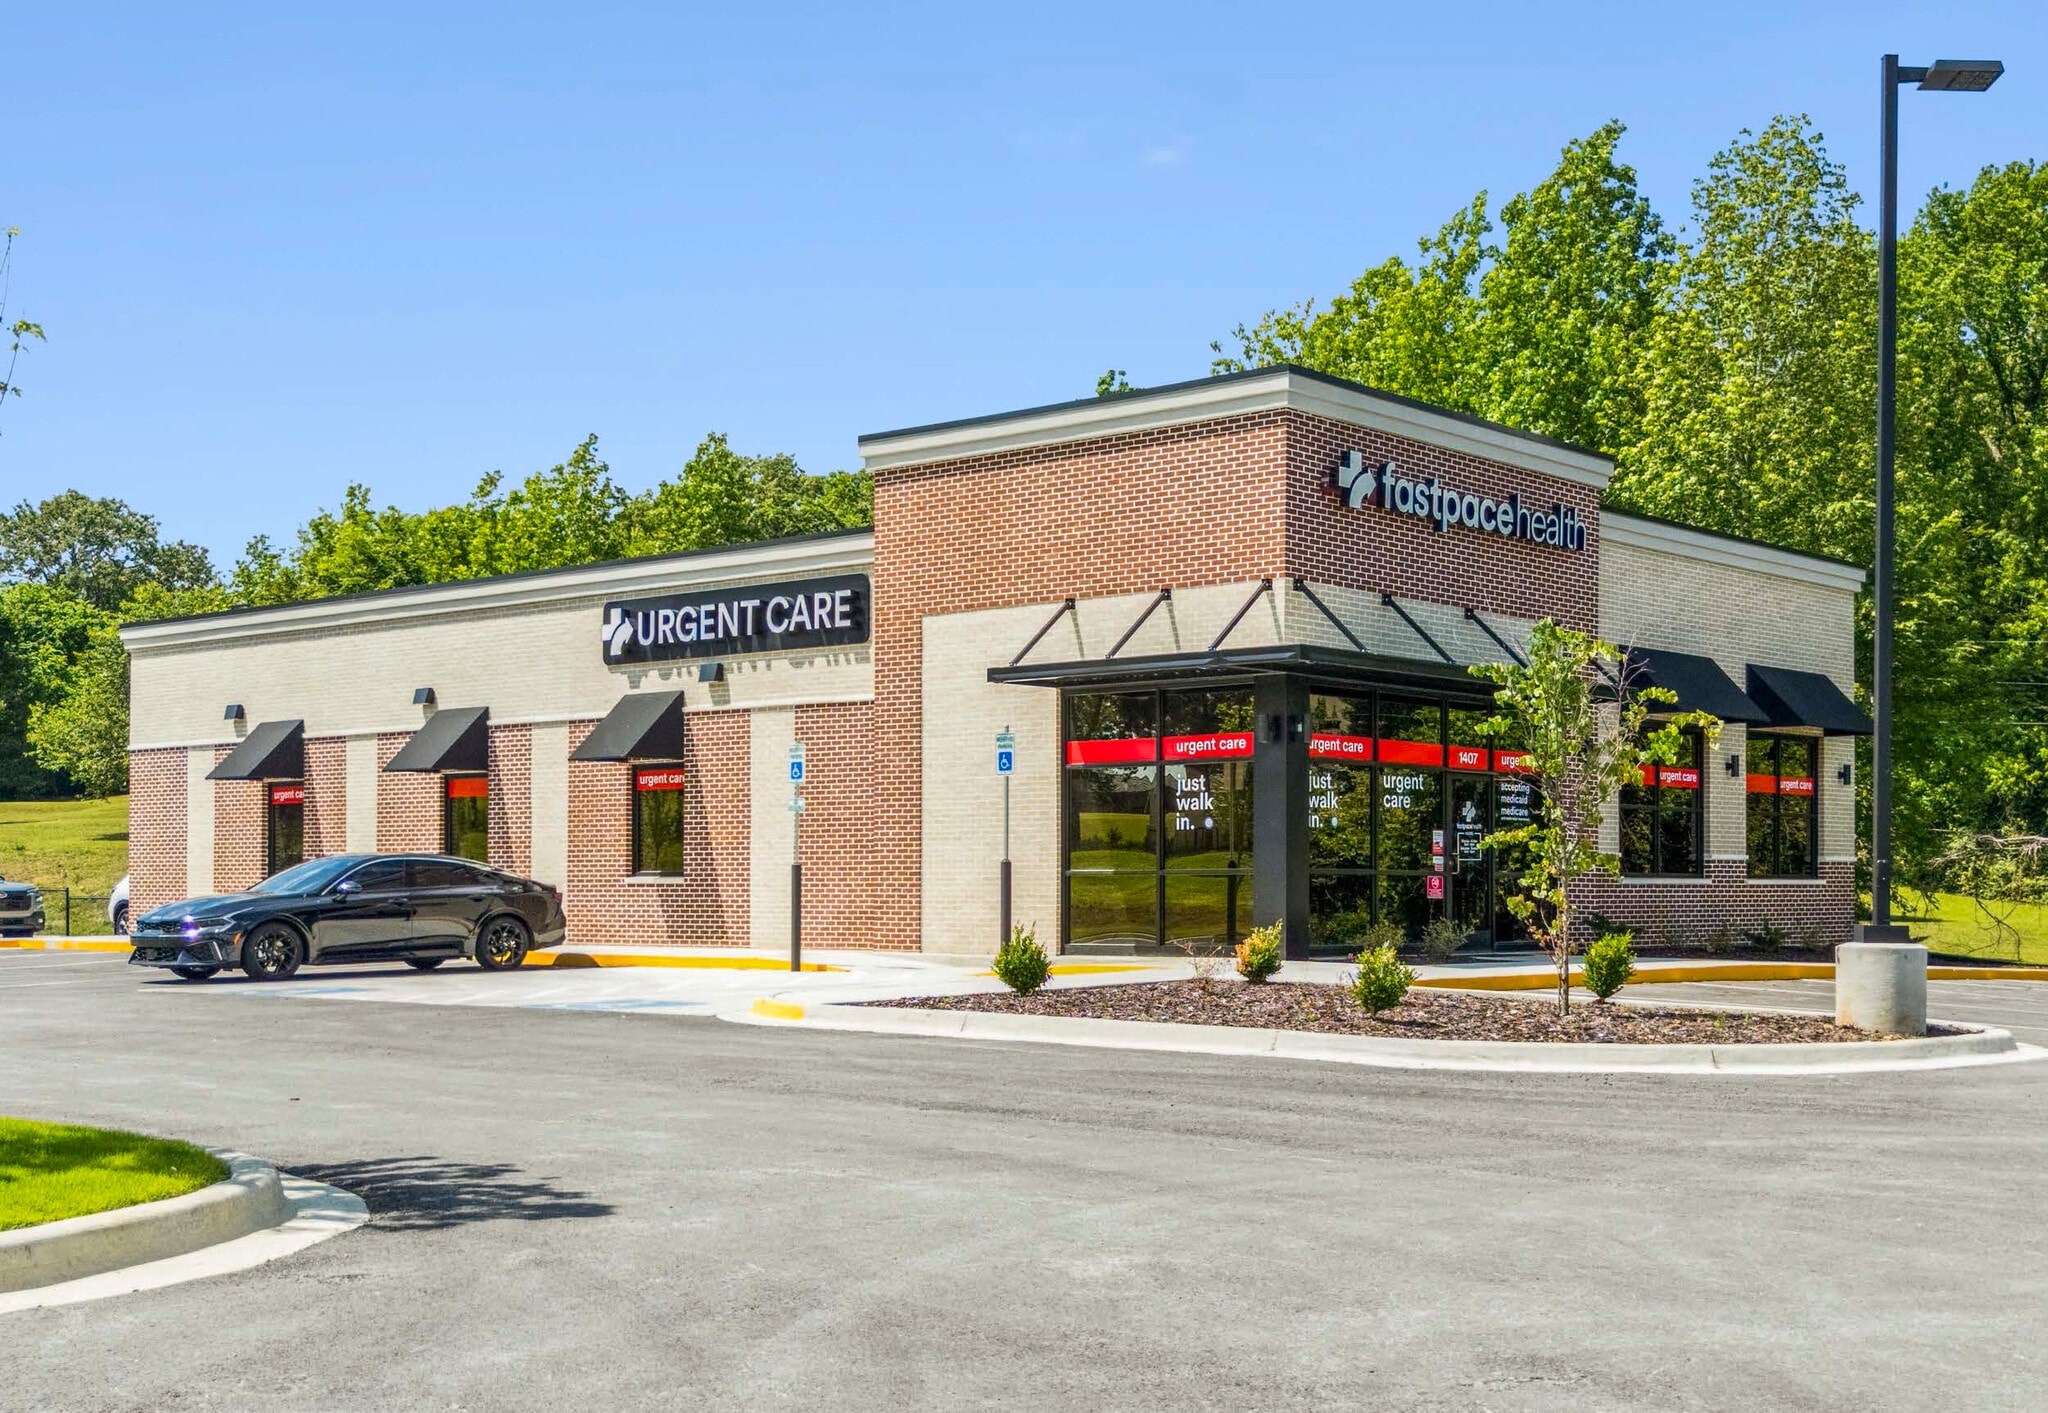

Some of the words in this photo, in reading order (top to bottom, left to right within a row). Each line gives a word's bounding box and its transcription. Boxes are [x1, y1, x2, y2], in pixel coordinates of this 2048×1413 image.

[1382, 462, 1587, 550] fastpacehealth
[637, 599, 760, 646] URGENT
[766, 589, 851, 634] CARE
[1176, 738, 1216, 754] urgent
[1219, 738, 1246, 749] care
[1342, 741, 1364, 752] care
[1458, 752, 1478, 765] 1407
[639, 773, 667, 786] urgent
[1176, 774, 1206, 795] just
[1309, 770, 1332, 792] just
[1383, 774, 1424, 793] urgent
[1660, 771, 1681, 783] urgent
[1682, 773, 1697, 782] care
[1780, 780, 1799, 790] urgent
[1800, 782, 1812, 790] care
[274, 790, 294, 801] urgent
[1176, 792, 1214, 811] walk
[1309, 791, 1338, 809] walk
[1383, 794, 1411, 809] care
[1176, 812, 1195, 830] in.
